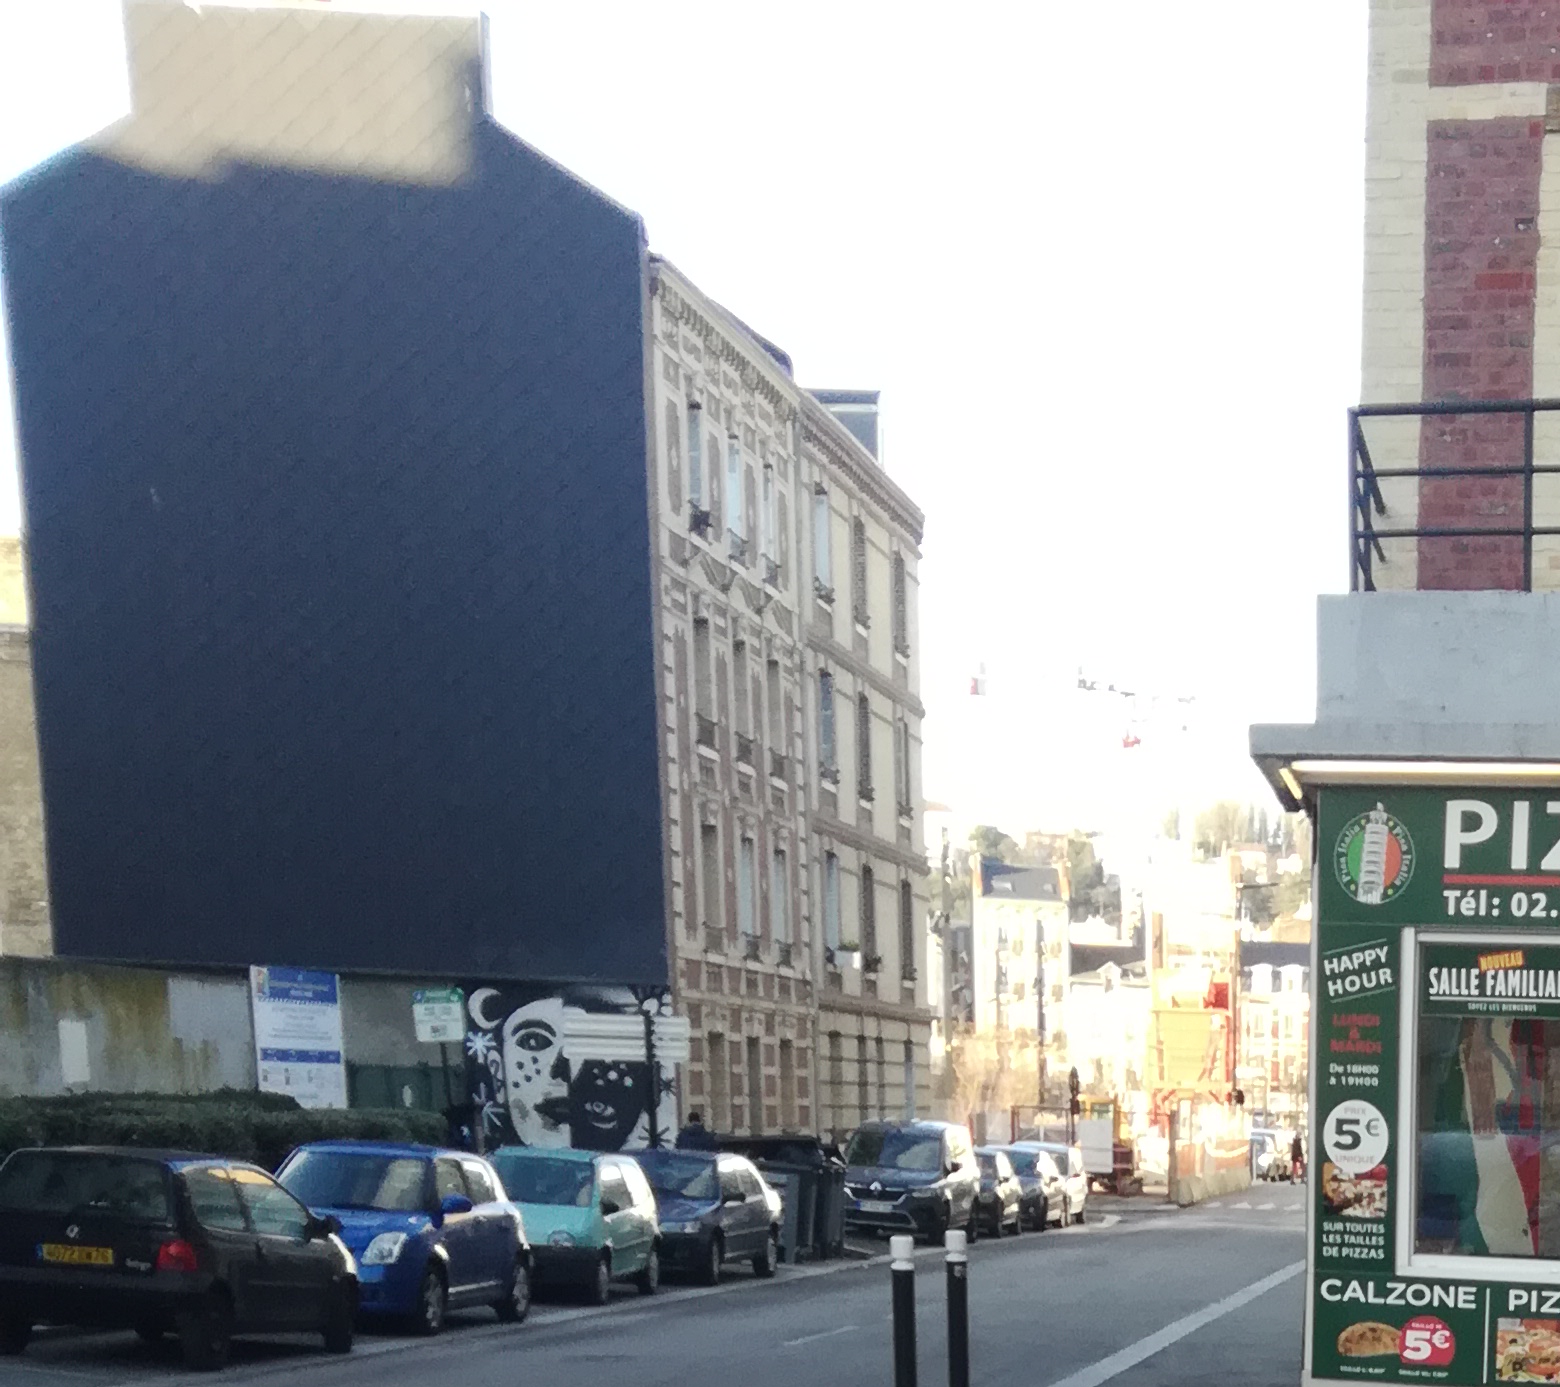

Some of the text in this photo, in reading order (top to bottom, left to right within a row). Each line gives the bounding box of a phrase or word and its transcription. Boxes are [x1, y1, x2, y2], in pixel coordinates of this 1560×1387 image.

[1443, 888, 1500, 917] Tél:
[1323, 945, 1388, 976] HAPPY
[1480, 951, 1523, 971] NOUVEAU
[1327, 968, 1393, 997] HOUR
[1429, 967, 1480, 996] SALLE
[1341, 1076, 1379, 1086] 19H00
[1344, 1107, 1366, 1115] PRIX
[1332, 1118, 1380, 1151] 5€
[1335, 1155, 1375, 1164] UNIQUE
[1323, 1222, 1385, 1234] SUR TOUTES
[1323, 1233, 1385, 1246] LES TAILLES
[1323, 1246, 1385, 1260] DE PIZZAS
[1320, 1278, 1477, 1309] CALZONE
[1403, 1329, 1450, 1361] 5€
